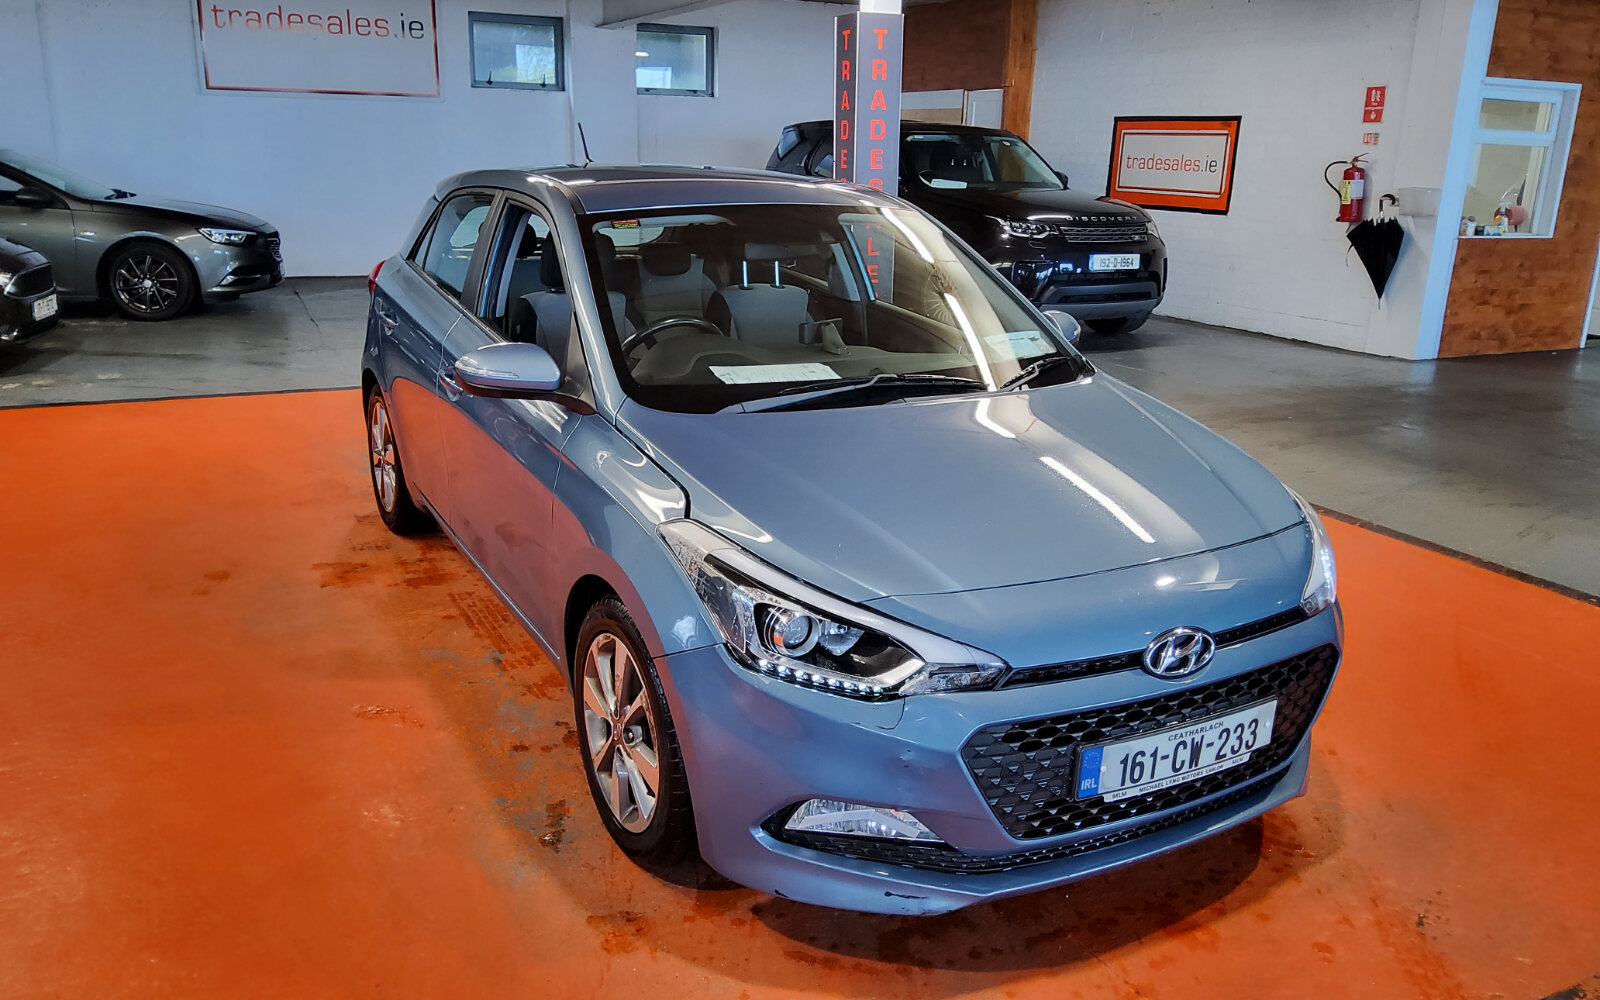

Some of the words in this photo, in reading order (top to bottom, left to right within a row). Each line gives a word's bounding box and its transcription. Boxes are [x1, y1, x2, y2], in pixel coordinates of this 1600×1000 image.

[211, 5, 425, 39] tradesales.ie
[839, 30, 851, 182] TRADE
[1126, 153, 1218, 173] tradesales.ie
[1168, 721, 1224, 741] CEATHARLACH
[1119, 718, 1259, 787] 161-CW-233
[1081, 778, 1098, 791] IRL
[1139, 782, 1165, 793] MICHAEL
[1181, 769, 1204, 781] MOTORS
